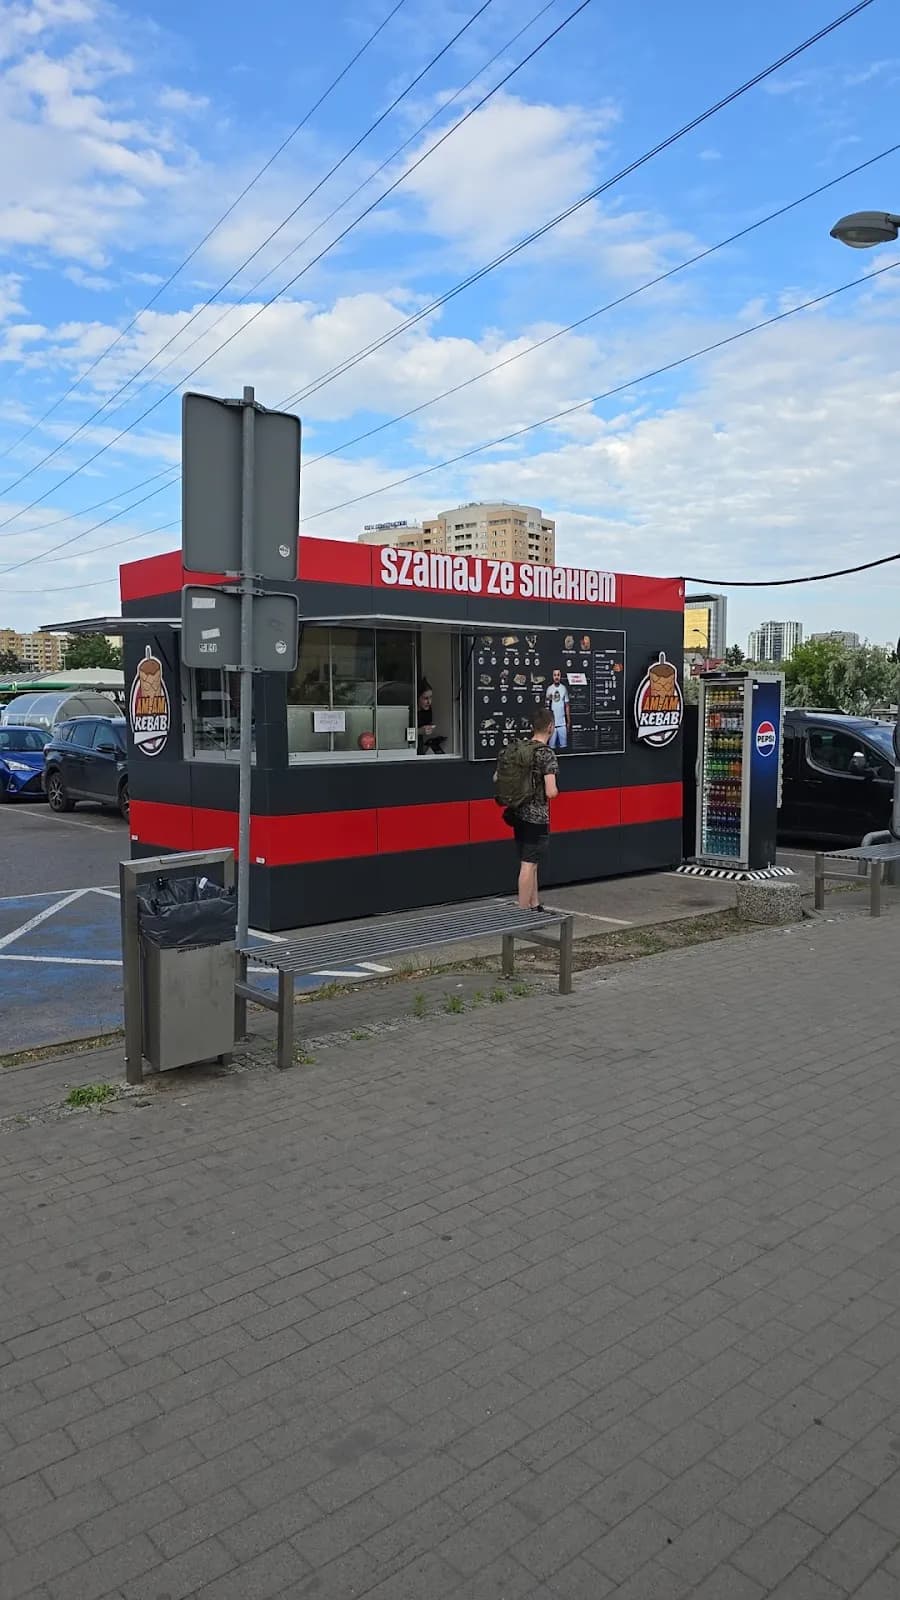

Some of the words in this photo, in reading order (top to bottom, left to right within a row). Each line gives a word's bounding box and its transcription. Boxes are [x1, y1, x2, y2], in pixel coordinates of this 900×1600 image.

[135, 714, 168, 732] KEBAB
[640, 711, 680, 726] KEBAB
[757, 735, 775, 743] PEPSI
